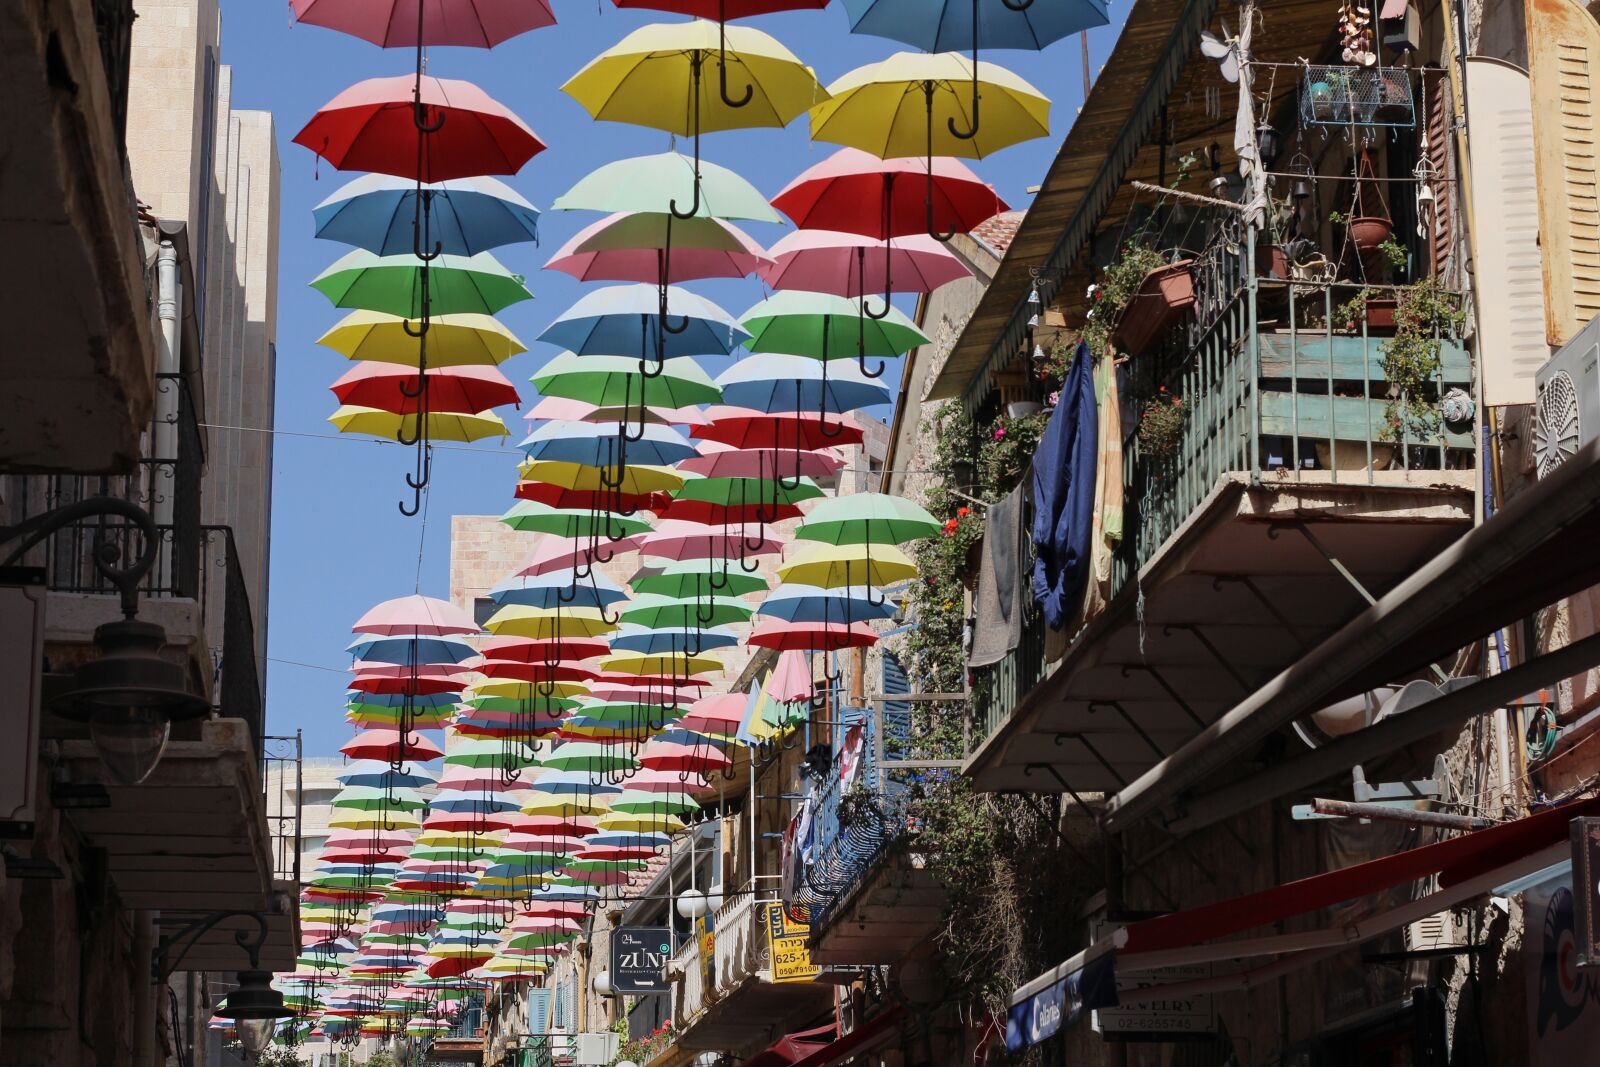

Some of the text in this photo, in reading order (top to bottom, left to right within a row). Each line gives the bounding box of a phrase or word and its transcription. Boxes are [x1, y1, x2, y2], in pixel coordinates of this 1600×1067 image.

[780, 938, 808, 948] כירה
[619, 947, 669, 969] ZUNI
[1115, 1000, 1195, 1011] WELRY
